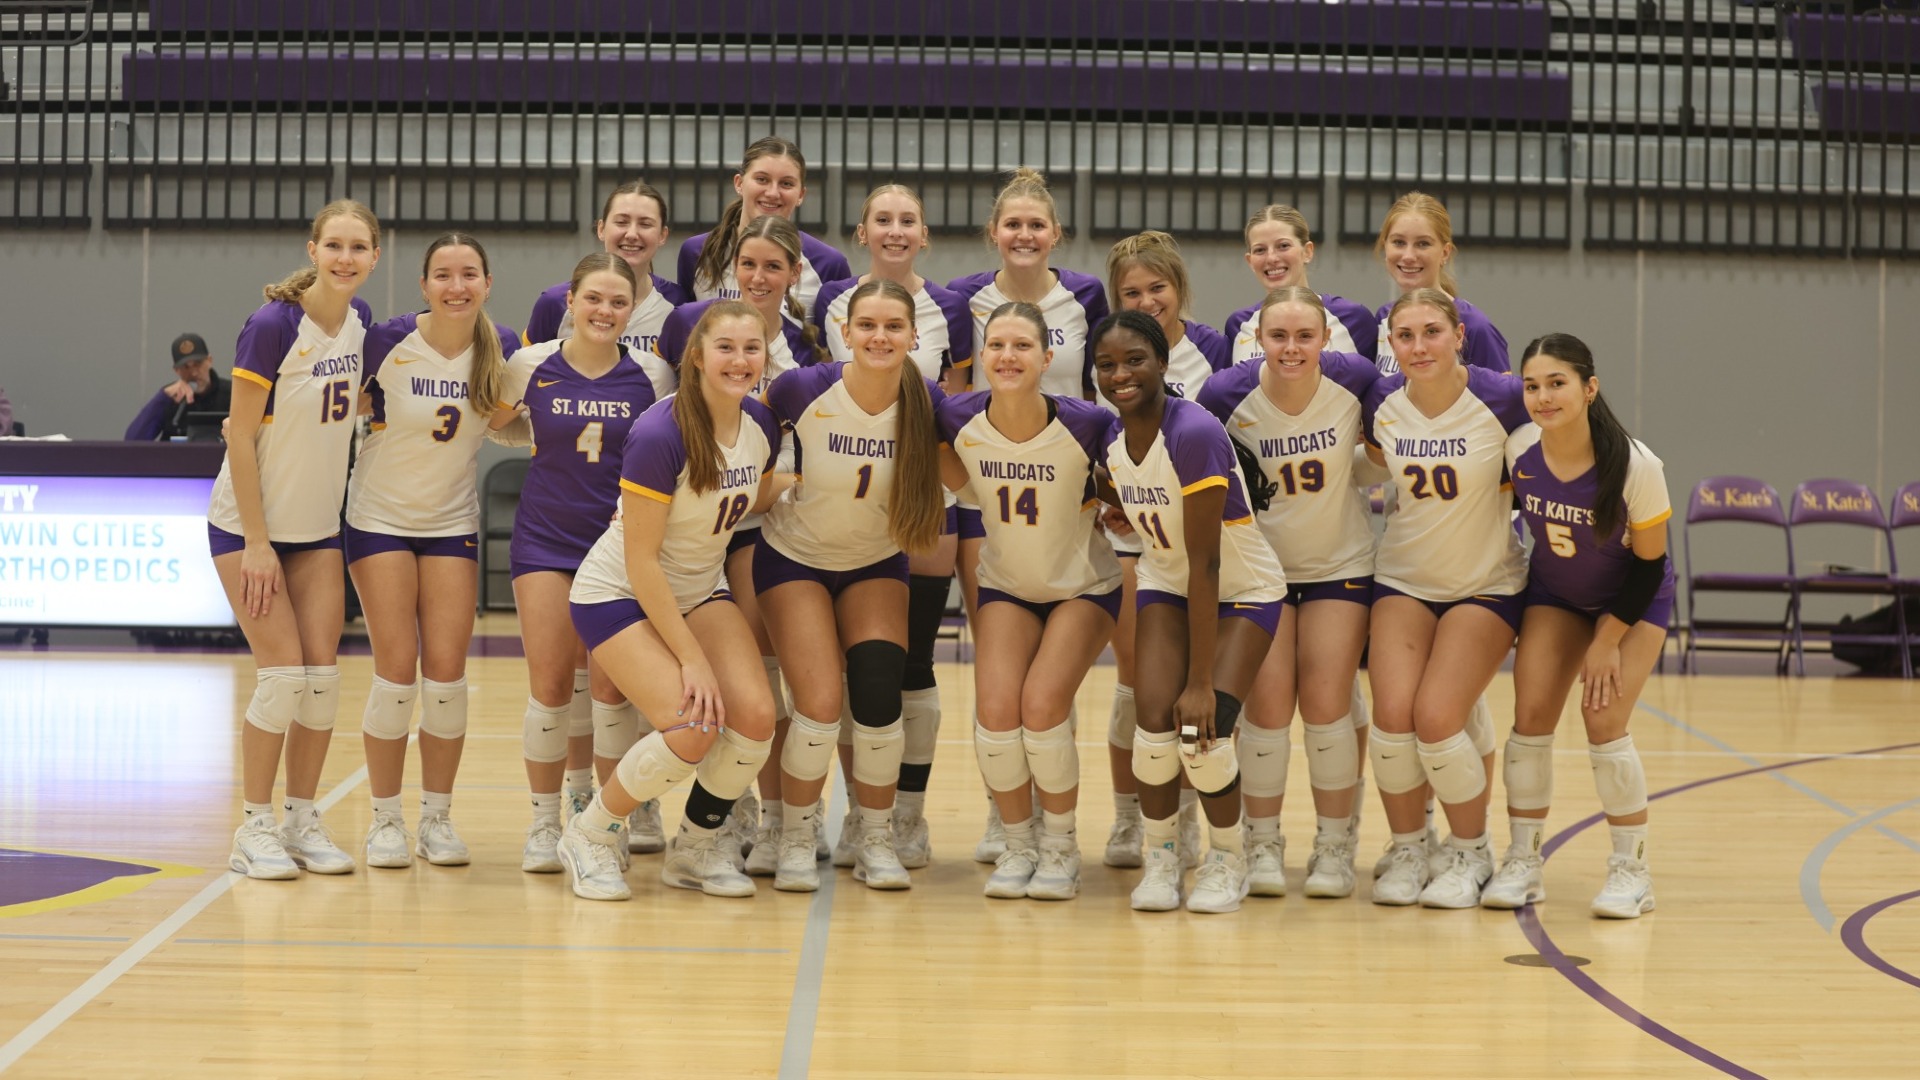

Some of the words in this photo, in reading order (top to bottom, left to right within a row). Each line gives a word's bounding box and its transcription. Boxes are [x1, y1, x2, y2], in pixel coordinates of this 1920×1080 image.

[312, 353, 358, 377] WILDCATS
[320, 378, 350, 424] 15
[411, 376, 470, 400] WILDCA
[431, 404, 463, 443] 3
[551, 397, 574, 415] ST.
[577, 399, 631, 418] KATE'S
[576, 421, 604, 463] 4
[828, 432, 896, 459] WILDCAT
[1259, 427, 1337, 458] WILDCATS
[1394, 437, 1467, 458] WILDCATS
[854, 463, 873, 500] 1
[979, 459, 1055, 482] WILDCATS
[1278, 458, 1326, 496] 19
[1402, 463, 1460, 501] 20
[996, 484, 1040, 526] 14
[1120, 484, 1170, 506] WILDCATS
[1525, 493, 1542, 516] ST.
[1545, 500, 1597, 526] KATE'S
[711, 492, 750, 536] 18
[1137, 511, 1172, 549] 11
[73, 522, 165, 547] CITIES
[1545, 521, 1577, 558] 5
